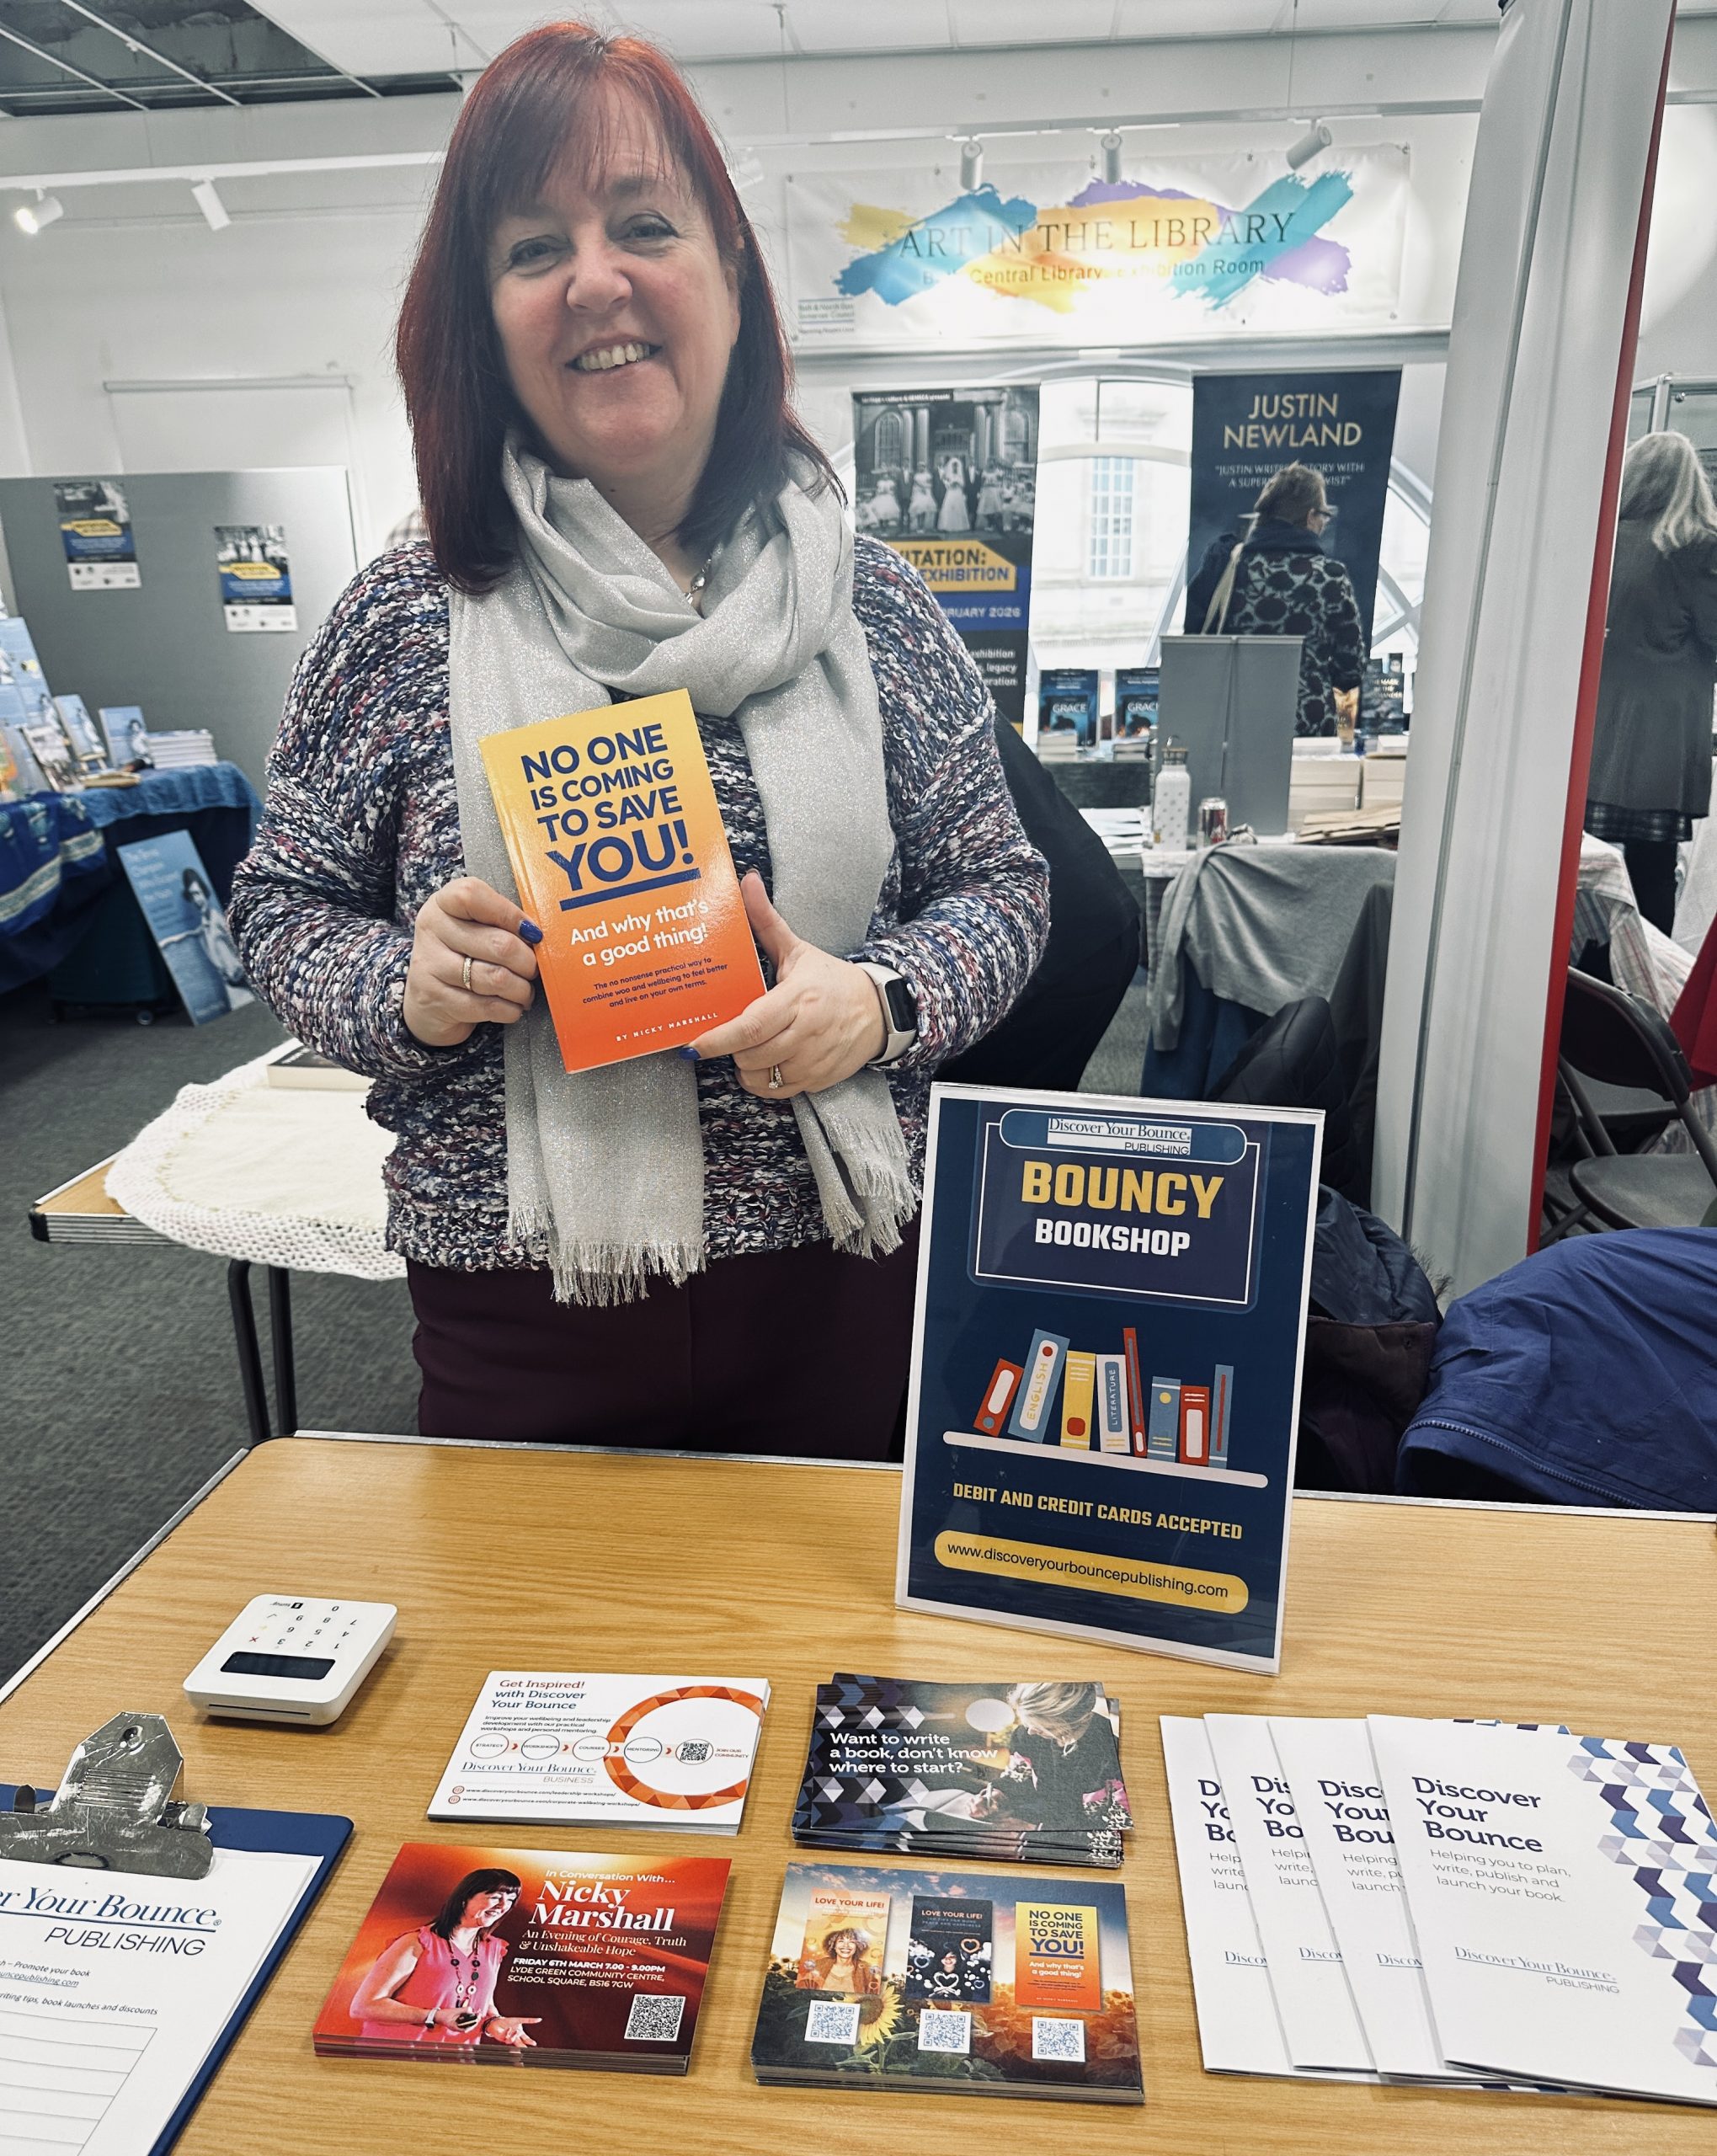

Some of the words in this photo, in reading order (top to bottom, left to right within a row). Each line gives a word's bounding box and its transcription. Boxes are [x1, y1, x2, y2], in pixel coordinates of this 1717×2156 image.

[899, 227, 972, 258] ART
[988, 224, 1024, 254] IN
[1037, 221, 1113, 252] THE
[1128, 212, 1296, 249] LIBRARY
[969, 266, 1035, 285] Central
[1213, 258, 1264, 275] Room
[1248, 393, 1339, 419] JUSTIN
[1224, 423, 1362, 449] NEWLAND
[1337, 463, 1365, 472] WITH
[989, 606, 1021, 618] 2026
[987, 663, 1017, 674] legacy
[1053, 703, 1087, 712] GRACE
[521, 745, 579, 782] NO
[588, 723, 668, 765] ONE
[531, 786, 557, 810] IS
[562, 759, 674, 801] COMING
[537, 809, 588, 842] TO
[595, 786, 682, 829] SAVE
[545, 819, 693, 891] YOU!
[571, 921, 608, 945] And
[611, 914, 651, 933] why
[655, 899, 709, 923] that's
[583, 953, 596, 965] a
[600, 936, 650, 966] good
[653, 923, 708, 948] thing!
[583, 992, 613, 1004] combine
[632, 983, 646, 991] and
[648, 975, 681, 988] wellbeing
[692, 969, 705, 977] feel
[707, 963, 728, 974] better
[620, 971, 653, 984] nonsense
[655, 963, 685, 977] practical
[688, 959, 702, 969] way
[610, 999, 623, 1007] and
[625, 995, 637, 1004] live
[650, 990, 667, 999] your
[685, 980, 707, 990] terms.
[633, 1026, 663, 1037] NICKY
[669, 1012, 718, 1029] MARSHALL
[1049, 1118, 1103, 1134] Discover
[1106, 1123, 1136, 1136] Your
[1125, 1142, 1189, 1155] PUBLISHING
[1021, 1161, 1224, 1219] BOUNCY
[1035, 1219, 1190, 1257] BOOKSHOP
[1028, 1363, 1048, 1420] ENGLISH
[1109, 1369, 1117, 1426] LITERATURE
[953, 1482, 997, 1502] DEBIT
[1000, 1490, 1033, 1508] AND
[1037, 1496, 1093, 1517] CREDIT
[1097, 1504, 1152, 1526] CARDS
[1155, 1513, 1242, 1540] ACCEPTED
[947, 1543, 1229, 1598] www.discoveryourbouncepublishing.com
[500, 1679, 523, 1688] Get
[525, 1680, 584, 1689] Inspired!
[529, 1690, 586, 1699] Discover
[829, 1732, 877, 1744] Want
[881, 1734, 900, 1744] to
[904, 1734, 950, 1744] write
[830, 1749, 840, 1758] a
[845, 1747, 894, 1760] book,
[898, 1748, 944, 1759] don't
[947, 1748, 998, 1758] know
[462, 1761, 515, 1771] Discover
[516, 1763, 547, 1772] Your
[829, 1761, 886, 1773] where
[891, 1764, 909, 1773] to
[913, 1762, 963, 1773] start?
[1411, 1776, 1541, 1808] Discover
[1416, 1798, 1488, 1822] Your
[1422, 1820, 1544, 1853] Bounce
[559, 1870, 633, 1881] Conversation
[1430, 1849, 1486, 1865] Helping
[1489, 1857, 1515, 1868] you
[1517, 1861, 1533, 1870] to
[1536, 1864, 1571, 1877] plan,
[1432, 1864, 1473, 1876] write,
[1475, 1869, 1528, 1884] publish
[1532, 1876, 1560, 1887] and
[22, 1886, 97, 1915] Your
[537, 1880, 631, 1908] Nicky
[1437, 1876, 1486, 1891] launch
[1489, 1884, 1521, 1896] your
[1524, 1889, 1566, 1903] book.
[529, 1903, 675, 1932] Marshall
[1030, 1910, 1050, 1919] NO
[1053, 1912, 1083, 1921] ONE
[1041, 1920, 1083, 1929] COMING
[44, 1927, 205, 1956] PUBLISHING
[522, 1929, 540, 1939] An
[541, 1930, 585, 1942] Evening
[588, 1933, 601, 1942] of
[655, 1936, 686, 1947] Truth
[1030, 1928, 1048, 1936] TO
[1051, 1929, 1083, 1939] SAVE
[1030, 1938, 1084, 1954] YOU!
[519, 1940, 531, 1950] &
[533, 1941, 603, 1955] Unshakeable
[605, 1945, 637, 1956] Hope
[1455, 1946, 1517, 1966] Discover
[1517, 1956, 1555, 1972] Your
[13, 1961, 49, 1972] Promote
[70, 1968, 91, 1977] book
[536, 1967, 566, 1976] GREEN
[568, 1969, 626, 1978] COMMUNITY
[627, 1973, 664, 1982] CENTRE,
[568, 1961, 603, 1969] MARCH
[507, 1975, 545, 1983] SCHOOL
[547, 1977, 587, 1987] SQUARE,
[1545, 1976, 1620, 1993] PUBLISHING
[23, 1994, 39, 2004] tips,
[42, 1998, 63, 2006] book
[64, 2000, 100, 2011] launches
[120, 2004, 158, 2015] discounts
